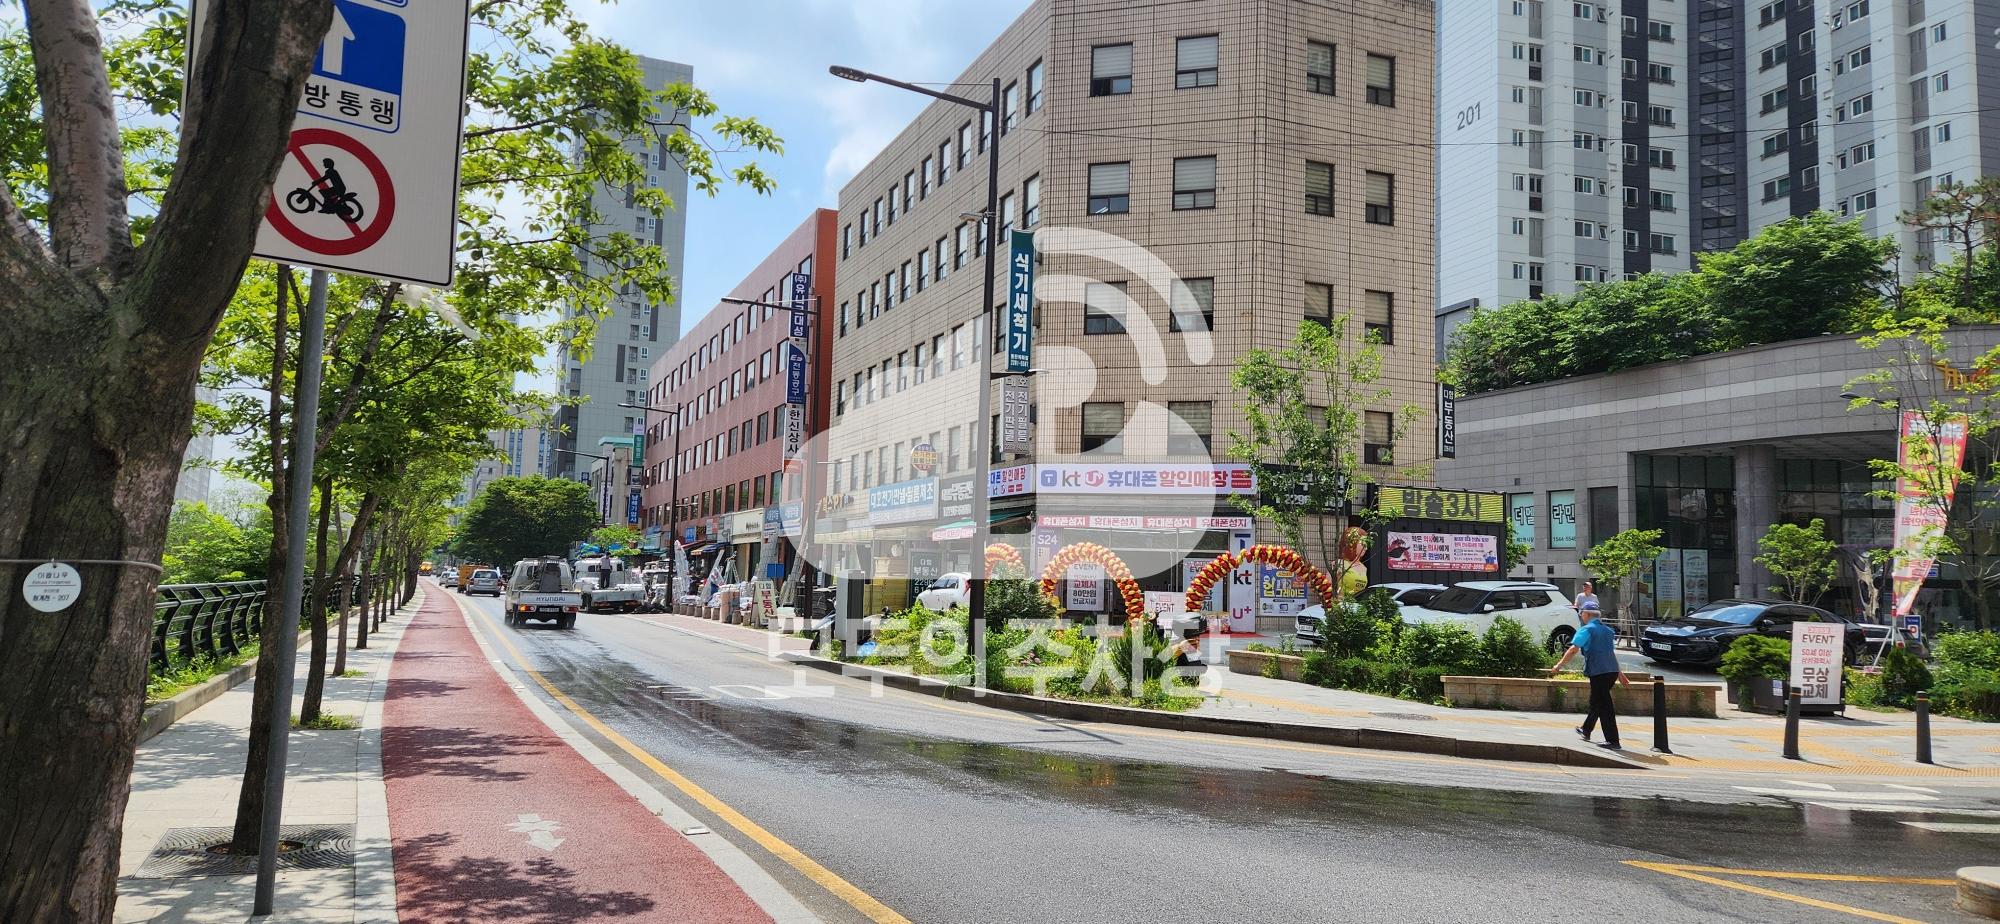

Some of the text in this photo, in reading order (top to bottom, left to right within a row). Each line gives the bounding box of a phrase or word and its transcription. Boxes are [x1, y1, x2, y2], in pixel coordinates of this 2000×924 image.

[304, 82, 394, 125] 방통행
[1457, 101, 1480, 130] 201
[1013, 252, 1029, 353] 식기세척기
[1444, 401, 1454, 444] 부동산
[787, 409, 801, 455] 한신상사
[1062, 470, 1080, 487] kt
[1108, 470, 1157, 488] 휴대폰
[1159, 470, 1228, 488] 할인매장
[1402, 489, 1482, 520] 방송3사
[1552, 503, 1575, 525] 라민
[1093, 517, 1138, 527] 휴대폰성지
[1148, 517, 1192, 528] 휴대폰성지
[1202, 518, 1247, 528] 휴대폰성지
[1038, 535, 1057, 545] S24
[913, 566, 938, 577] 부동산
[1233, 570, 1252, 585] kt
[1073, 580, 1096, 588] 교체시
[1155, 602, 1175, 612] EVENT
[1802, 634, 1836, 644] EVENT
[1818, 649, 1832, 657] 이상
[1802, 667, 1830, 683] 무상
[1801, 683, 1828, 699] 교체
